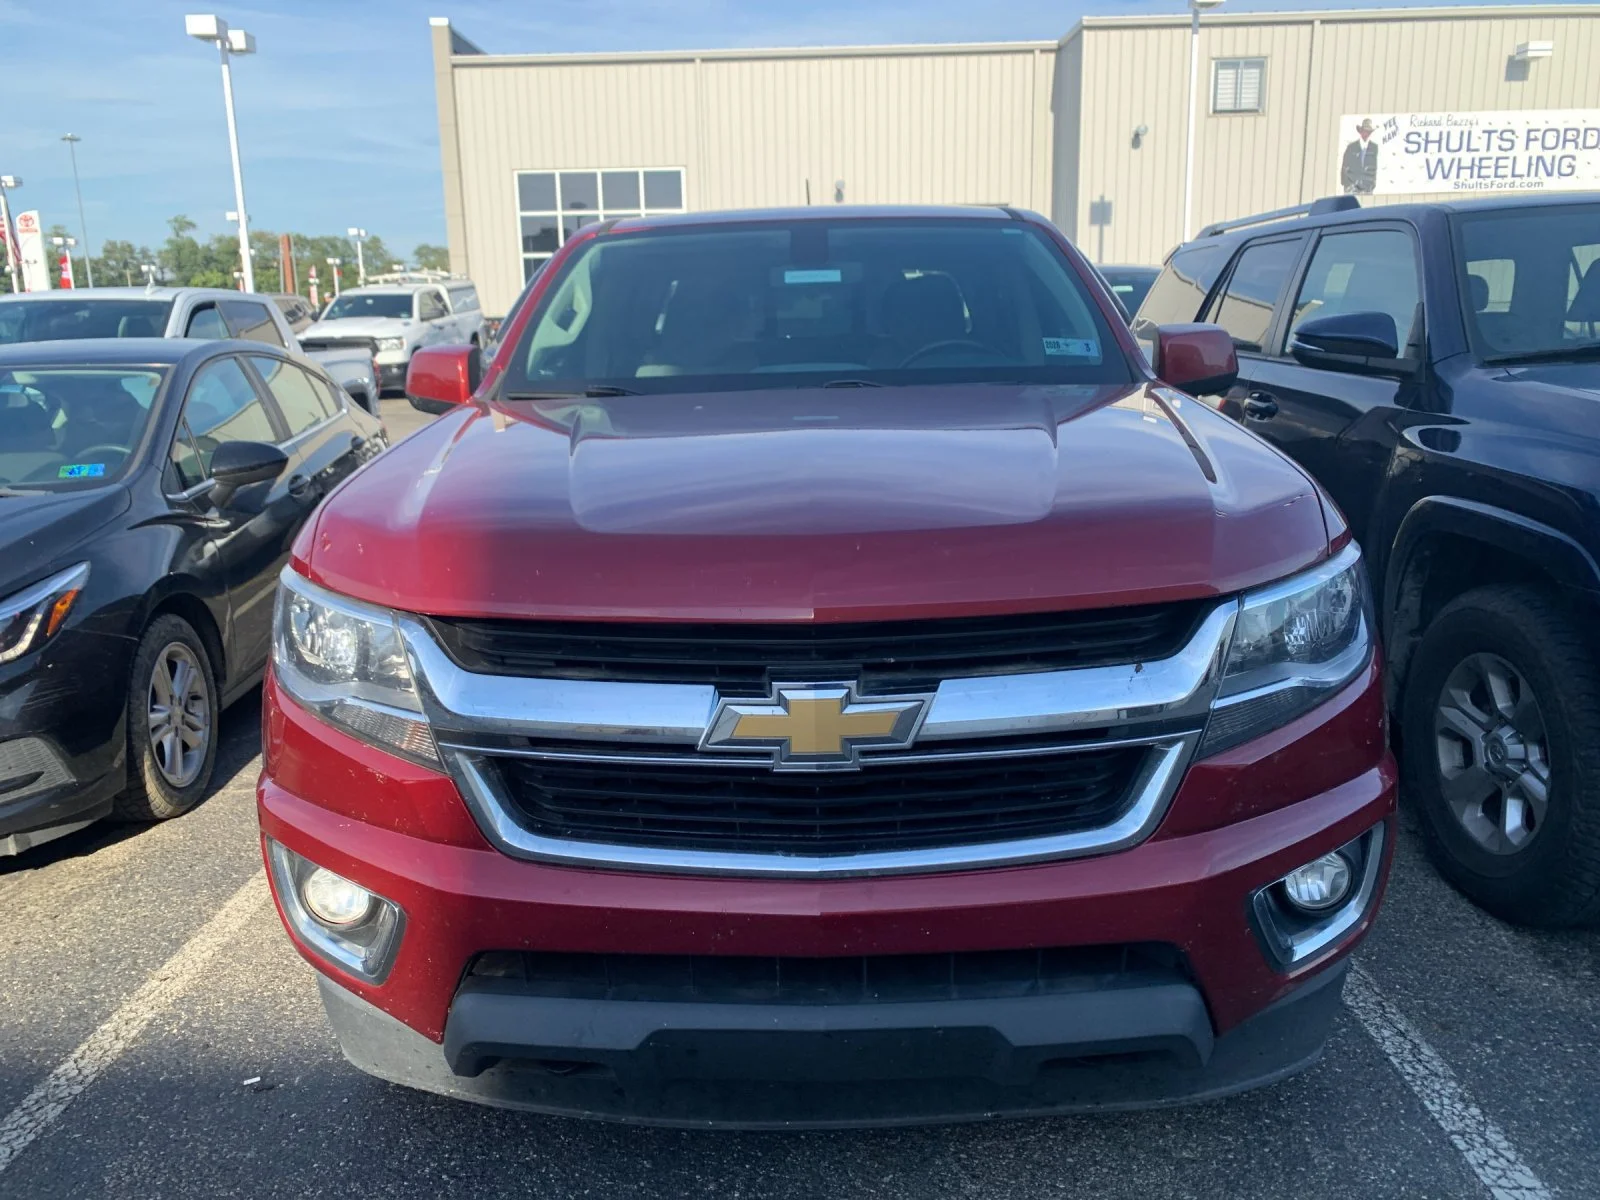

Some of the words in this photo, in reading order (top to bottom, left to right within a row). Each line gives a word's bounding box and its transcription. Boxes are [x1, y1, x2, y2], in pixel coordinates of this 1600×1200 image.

[1404, 129, 1516, 154] SHULTS
[1525, 127, 1600, 151] FORD
[1425, 154, 1577, 180] WHEELING
[1453, 180, 1544, 190] ShultsFord.com
